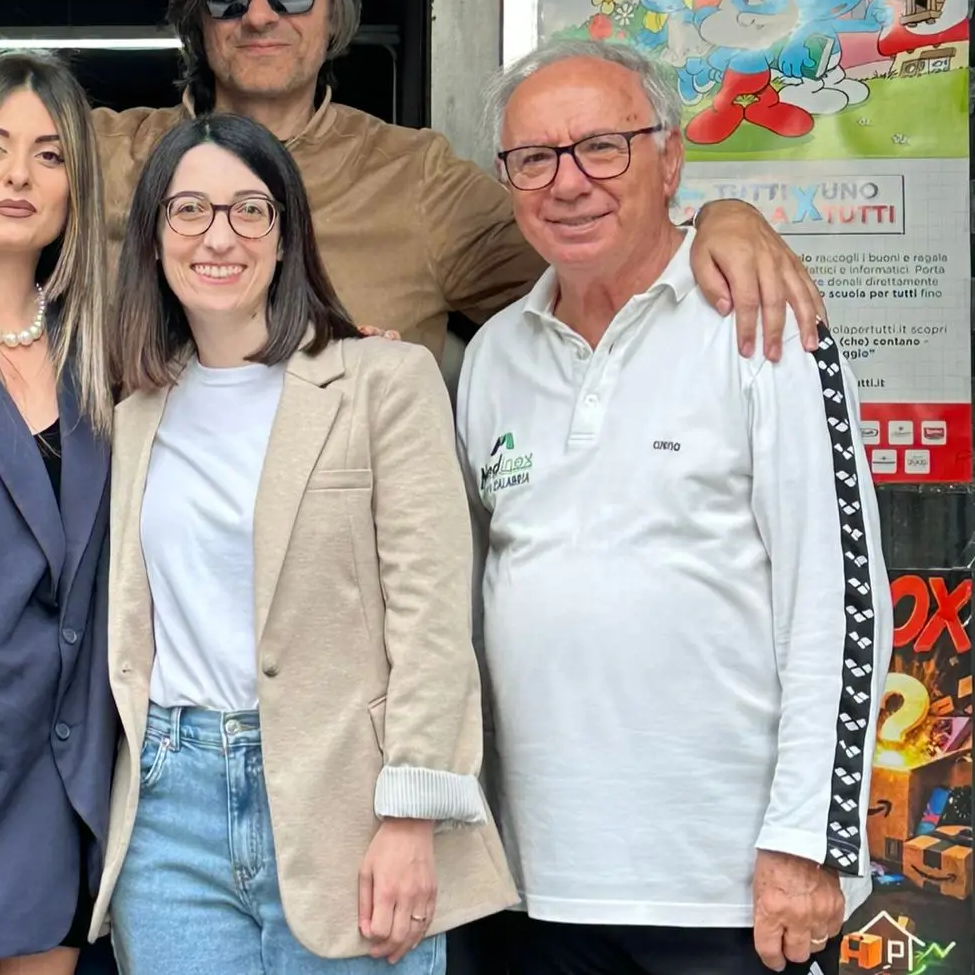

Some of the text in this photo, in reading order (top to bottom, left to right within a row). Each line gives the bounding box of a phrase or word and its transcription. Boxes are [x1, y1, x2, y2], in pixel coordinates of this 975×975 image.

[822, 182, 879, 201] UNO
[823, 205, 895, 224] TUTTI
[816, 253, 859, 264] raccogli
[869, 253, 900, 263] buoni
[903, 254, 910, 263] e
[914, 253, 948, 264] regala
[807, 266, 837, 275] attici
[840, 267, 846, 275] e
[915, 265, 945, 275] Porta
[866, 277, 939, 286] direttamente
[829, 288, 866, 298] scuola
[870, 290, 890, 299] per
[893, 288, 917, 298] tutti
[921, 288, 942, 298] fino
[911, 324, 948, 335] scopri
[840, 337, 869, 347] (che)
[873, 337, 920, 346] contano
[891, 575, 972, 653] OX
